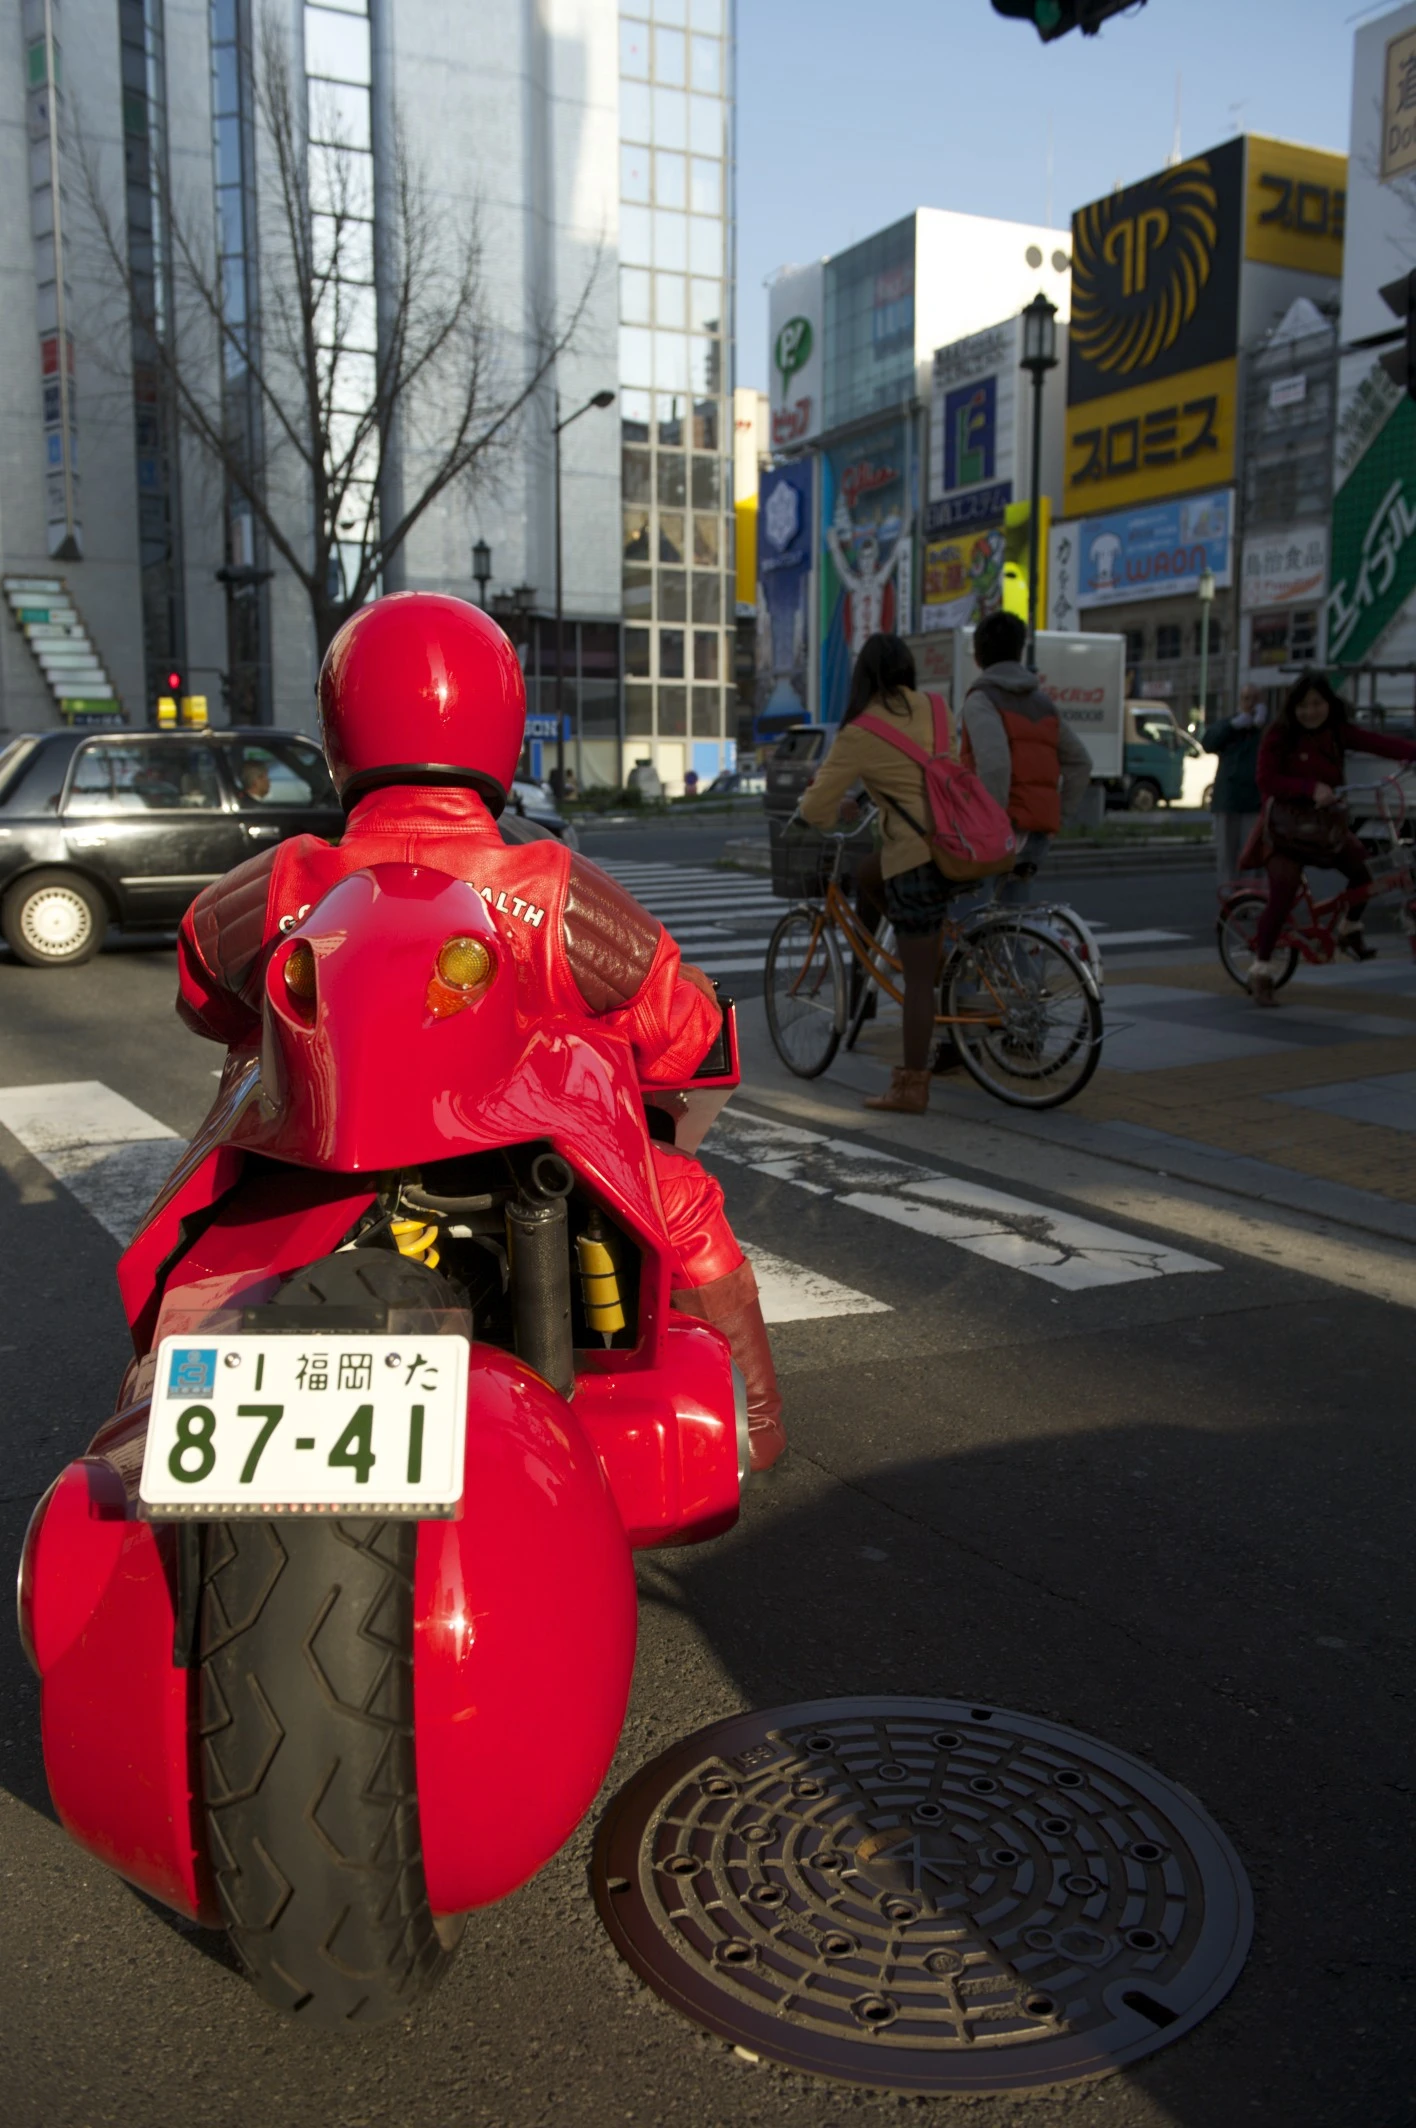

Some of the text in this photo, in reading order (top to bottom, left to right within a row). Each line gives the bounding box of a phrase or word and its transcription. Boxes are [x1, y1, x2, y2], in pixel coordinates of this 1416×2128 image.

[1070, 394, 1220, 485] プロミス
[1126, 543, 1207, 583] WAON
[254, 1352, 439, 1392] 1 福岡 た
[167, 1404, 426, 1484] 87-41
